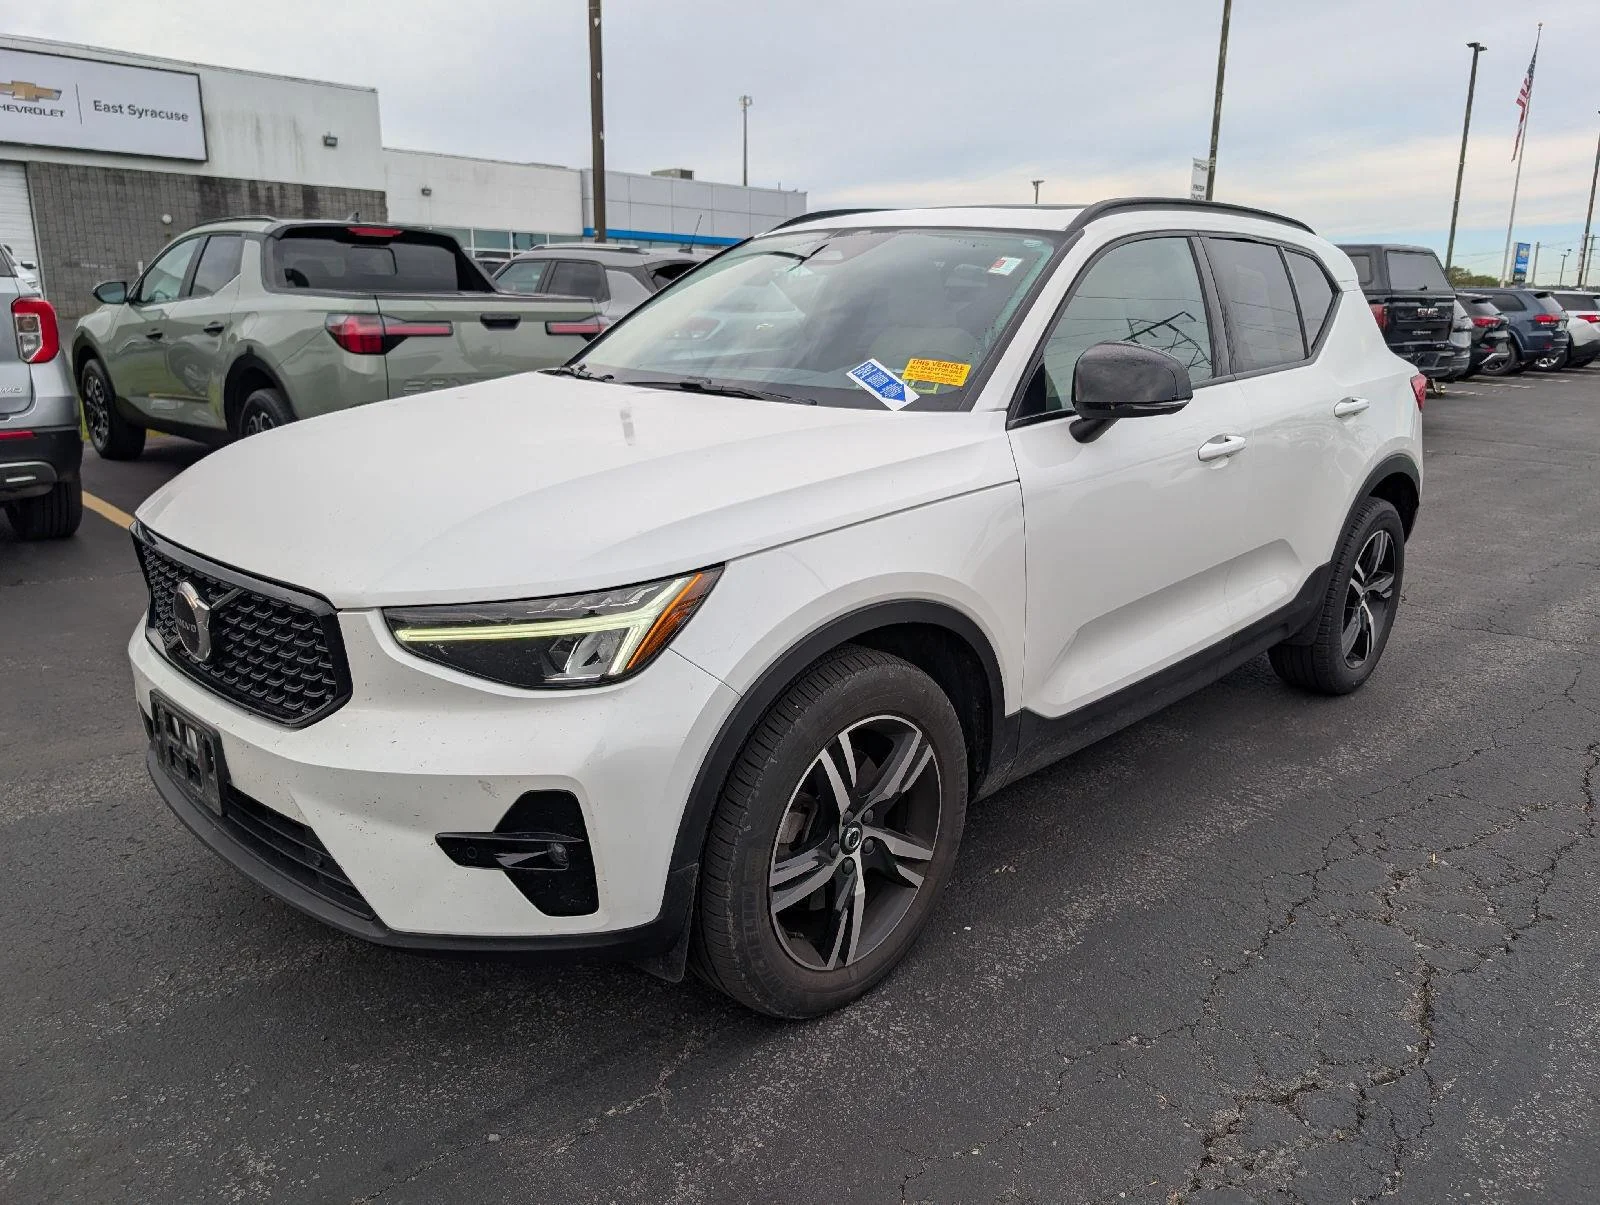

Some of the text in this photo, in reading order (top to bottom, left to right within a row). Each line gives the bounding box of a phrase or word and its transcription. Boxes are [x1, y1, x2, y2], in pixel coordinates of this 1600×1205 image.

[0, 104, 65, 117] HEVROLET
[93, 100, 189, 122] East Syracuse
[912, 359, 965, 371] THIS VEHICLE
